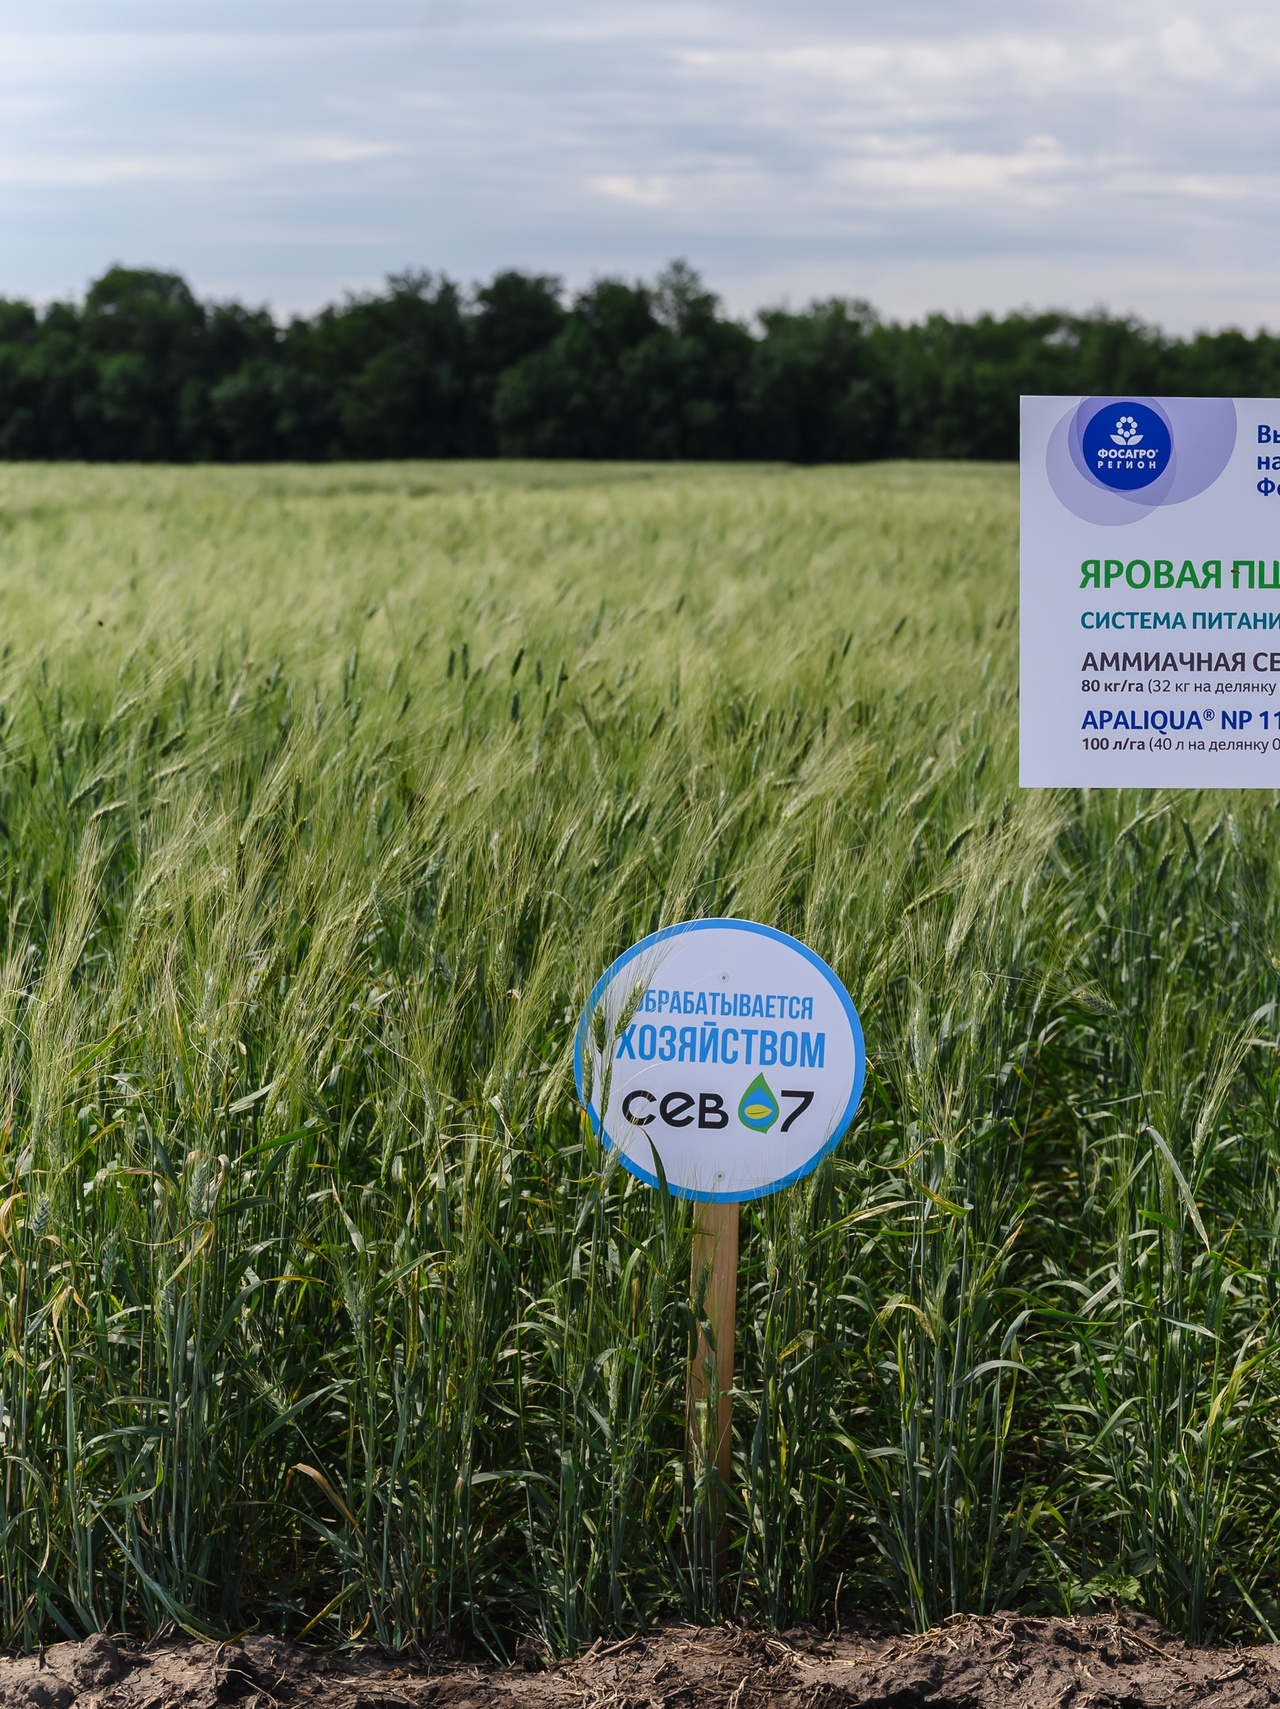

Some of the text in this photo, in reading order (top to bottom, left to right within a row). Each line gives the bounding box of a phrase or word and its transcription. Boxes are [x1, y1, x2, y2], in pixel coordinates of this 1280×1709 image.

[1097, 460, 1156, 469] РЕГИОН
[1079, 559, 1222, 590] ЯРОВАЯ
[1080, 611, 1187, 630] СИСТЕМА
[1080, 651, 1246, 672] АММИАЧНАЯ
[1081, 679, 1101, 693] 80
[1104, 679, 1144, 693] кг/га
[1147, 678, 1171, 695] (32
[1175, 682, 1191, 693] кг
[1194, 682, 1212, 693] на
[1214, 682, 1277, 697] делянку
[1080, 708, 1216, 736] APALIQUA®
[1221, 709, 1253, 731] NP
[1082, 737, 1110, 751] 100
[1112, 737, 1146, 751] л/га
[1148, 736, 1173, 753] (40
[1175, 740, 1185, 751] л
[1188, 740, 1206, 751] на
[1208, 740, 1270, 755] делянку
[615, 1021, 826, 1069] ХОЗЯЙСТВОМ
